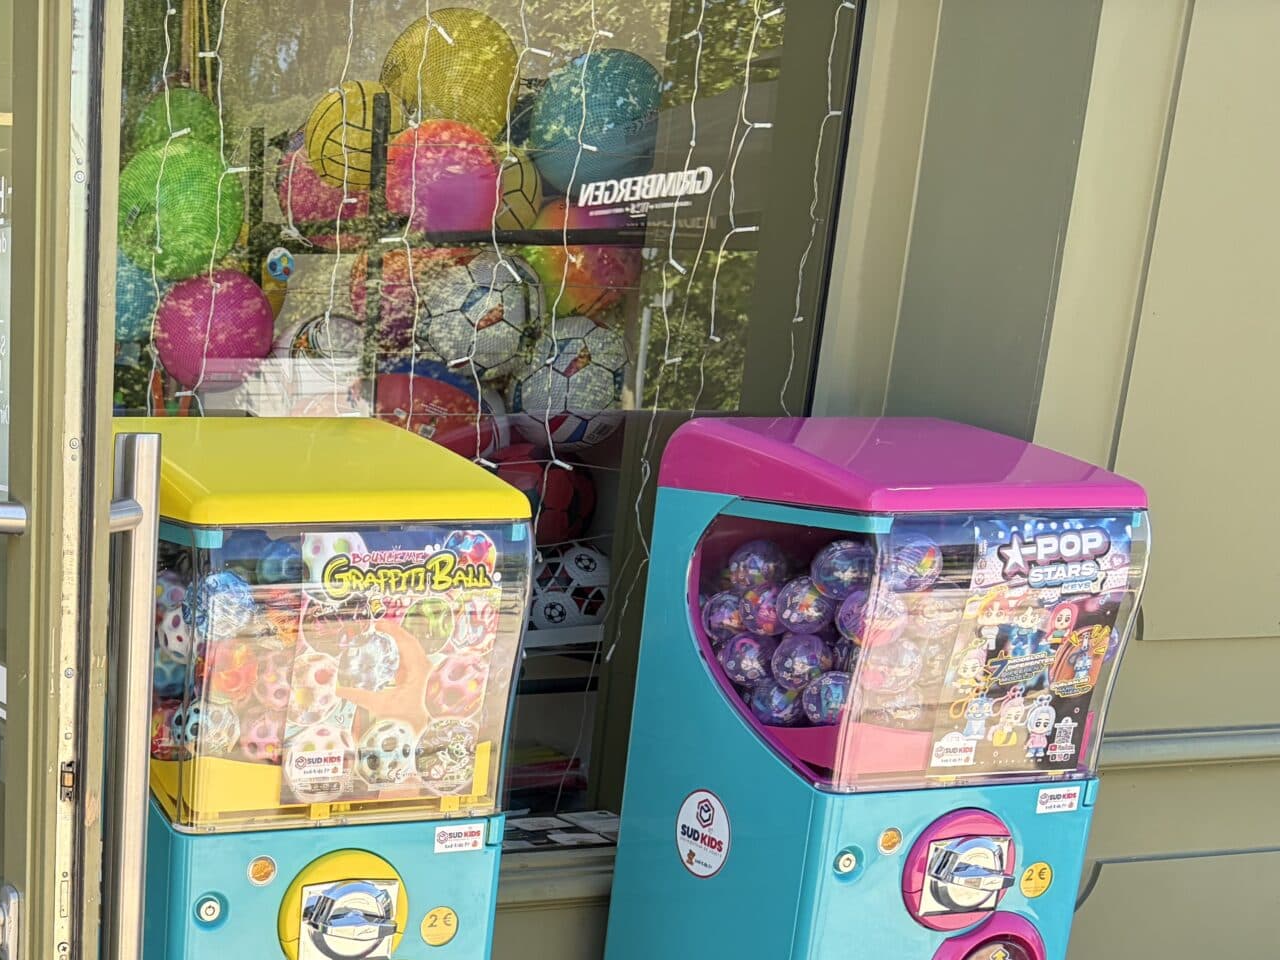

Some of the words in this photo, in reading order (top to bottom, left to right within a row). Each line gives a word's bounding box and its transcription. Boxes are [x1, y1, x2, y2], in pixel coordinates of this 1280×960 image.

[323, 555, 426, 599] GRAFFITI
[425, 551, 493, 592] BALL
[1029, 561, 1096, 583] STARS
[307, 757, 322, 765] SUD
[323, 755, 342, 763] KIDS
[1048, 794, 1061, 802] SUD
[1062, 792, 1077, 800] KIDS
[448, 831, 463, 839] SUD
[463, 830, 481, 838] KIDS
[680, 823, 700, 841] SUD
[700, 832, 724, 853] KIDS
[1025, 869, 1033, 882] 2
[1037, 867, 1048, 880] €
[427, 914, 438, 928] 2
[443, 912, 453, 926] €
